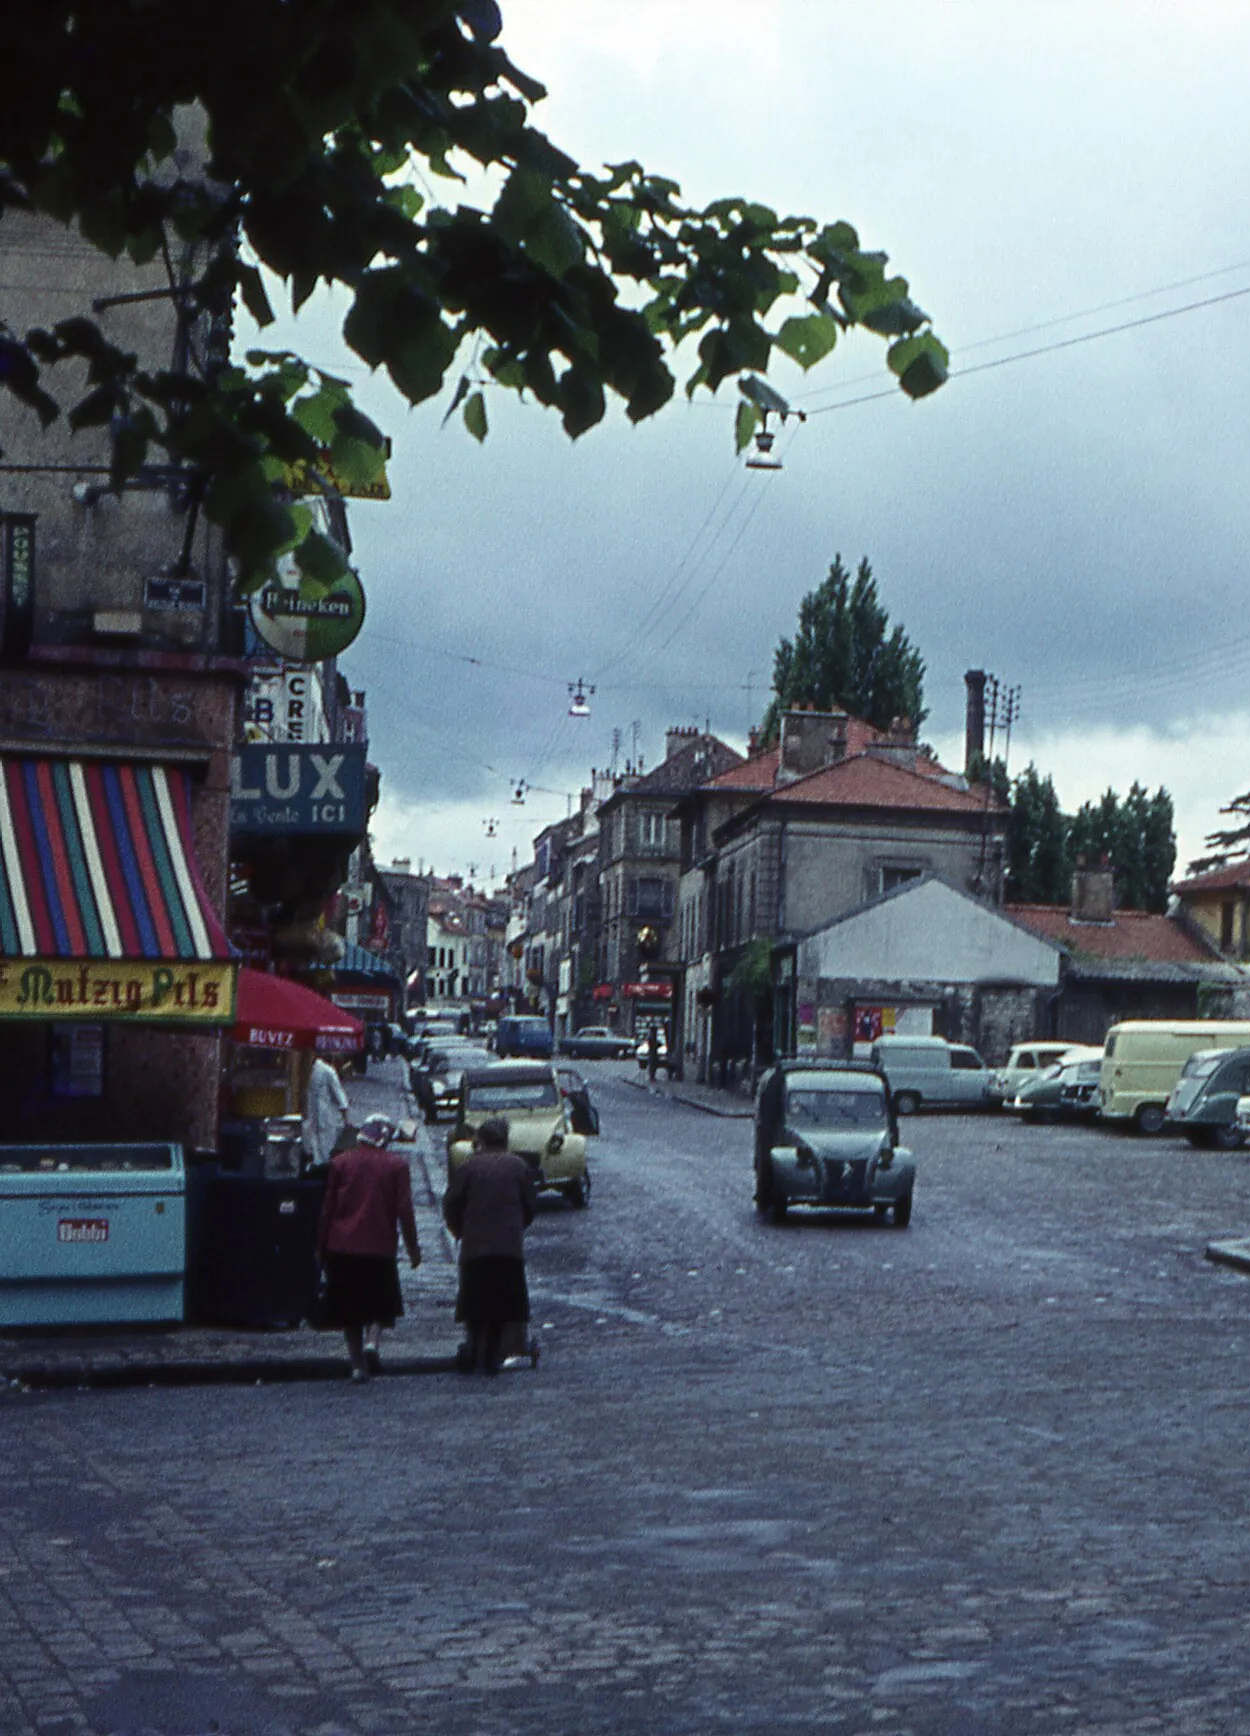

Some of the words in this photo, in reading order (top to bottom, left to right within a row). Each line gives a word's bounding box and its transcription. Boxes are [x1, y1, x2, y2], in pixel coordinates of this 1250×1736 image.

[231, 753, 345, 800] LUX
[312, 804, 345, 823] ICI
[17, 964, 144, 1012] Mutzig
[151, 966, 221, 1008] Pils
